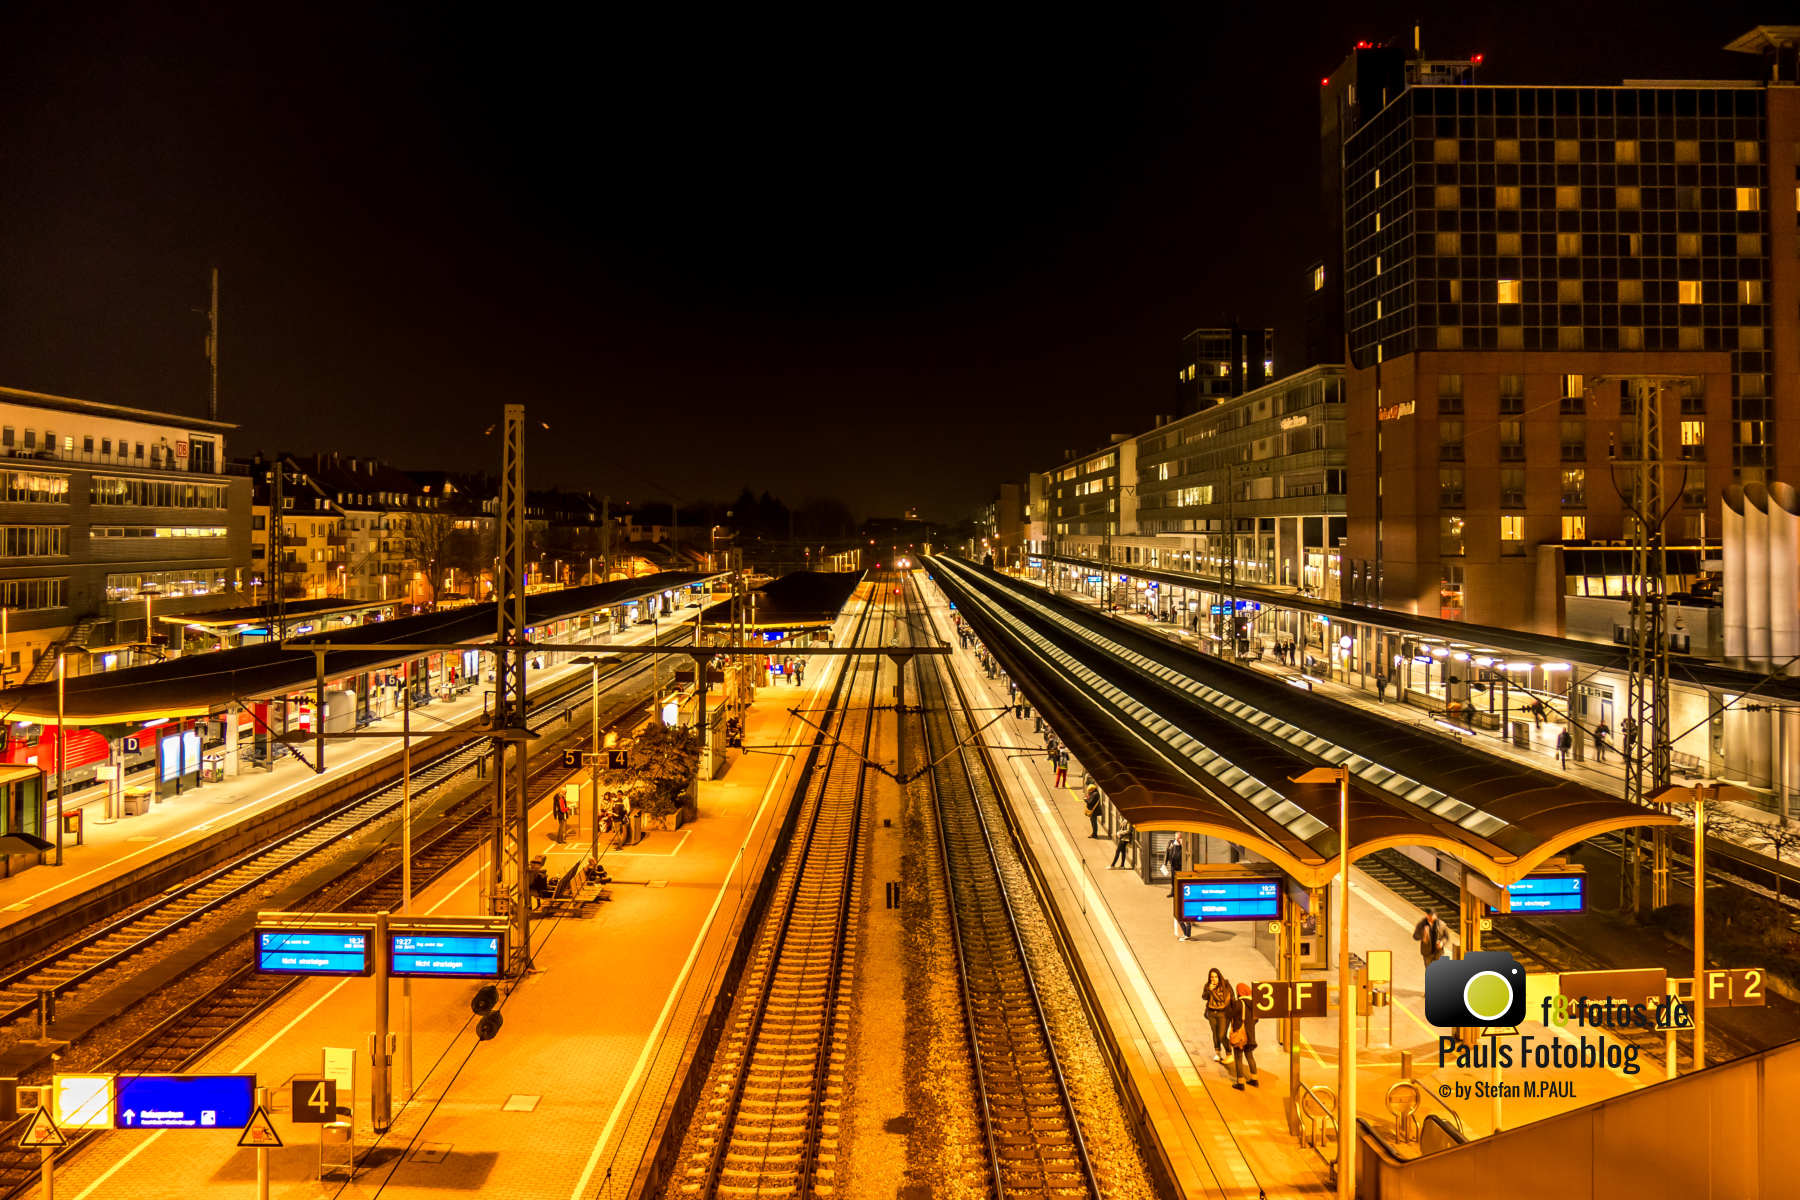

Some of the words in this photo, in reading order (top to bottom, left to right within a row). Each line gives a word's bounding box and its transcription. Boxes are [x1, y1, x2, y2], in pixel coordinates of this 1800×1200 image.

[128, 738, 138, 751] D
[565, 750, 575, 765] 5
[615, 750, 625, 766] 4
[1183, 885, 1191, 897] 3
[1572, 879, 1580, 890] 2
[262, 934, 270, 946] 5
[489, 938, 497, 951] 4
[1709, 972, 1726, 1000] F
[1743, 970, 1761, 998] 2
[1256, 982, 1275, 1011] 3
[1295, 982, 1313, 1010] F
[307, 1081, 329, 1114] 4
